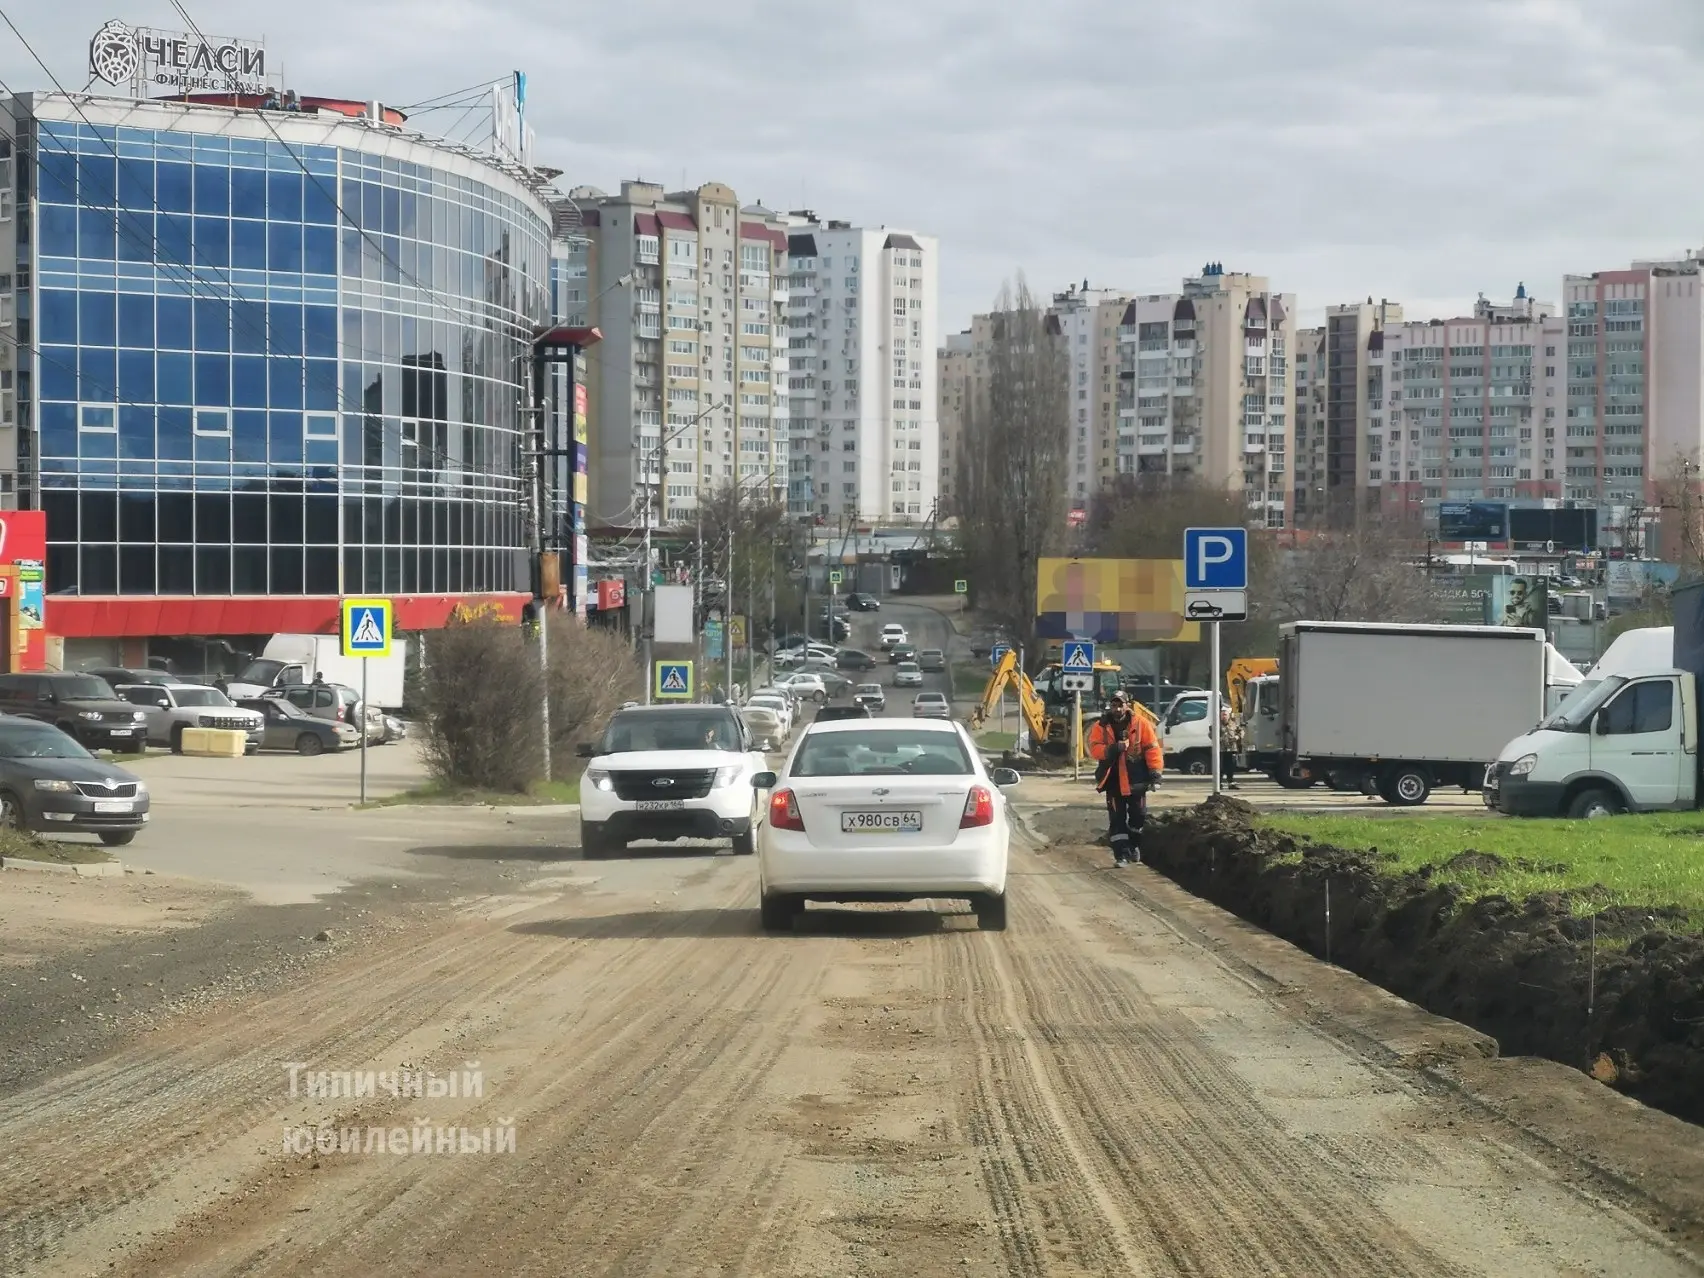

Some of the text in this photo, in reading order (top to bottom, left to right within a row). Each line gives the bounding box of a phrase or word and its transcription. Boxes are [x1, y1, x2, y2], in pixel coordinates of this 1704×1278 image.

[143, 35, 266, 78] ЧЕЛСИ
[155, 73, 266, 95] ФИТНЕС КЛУБ
[1198, 536, 1233, 581] P
[848, 813, 917, 827] Х980СВ 64
